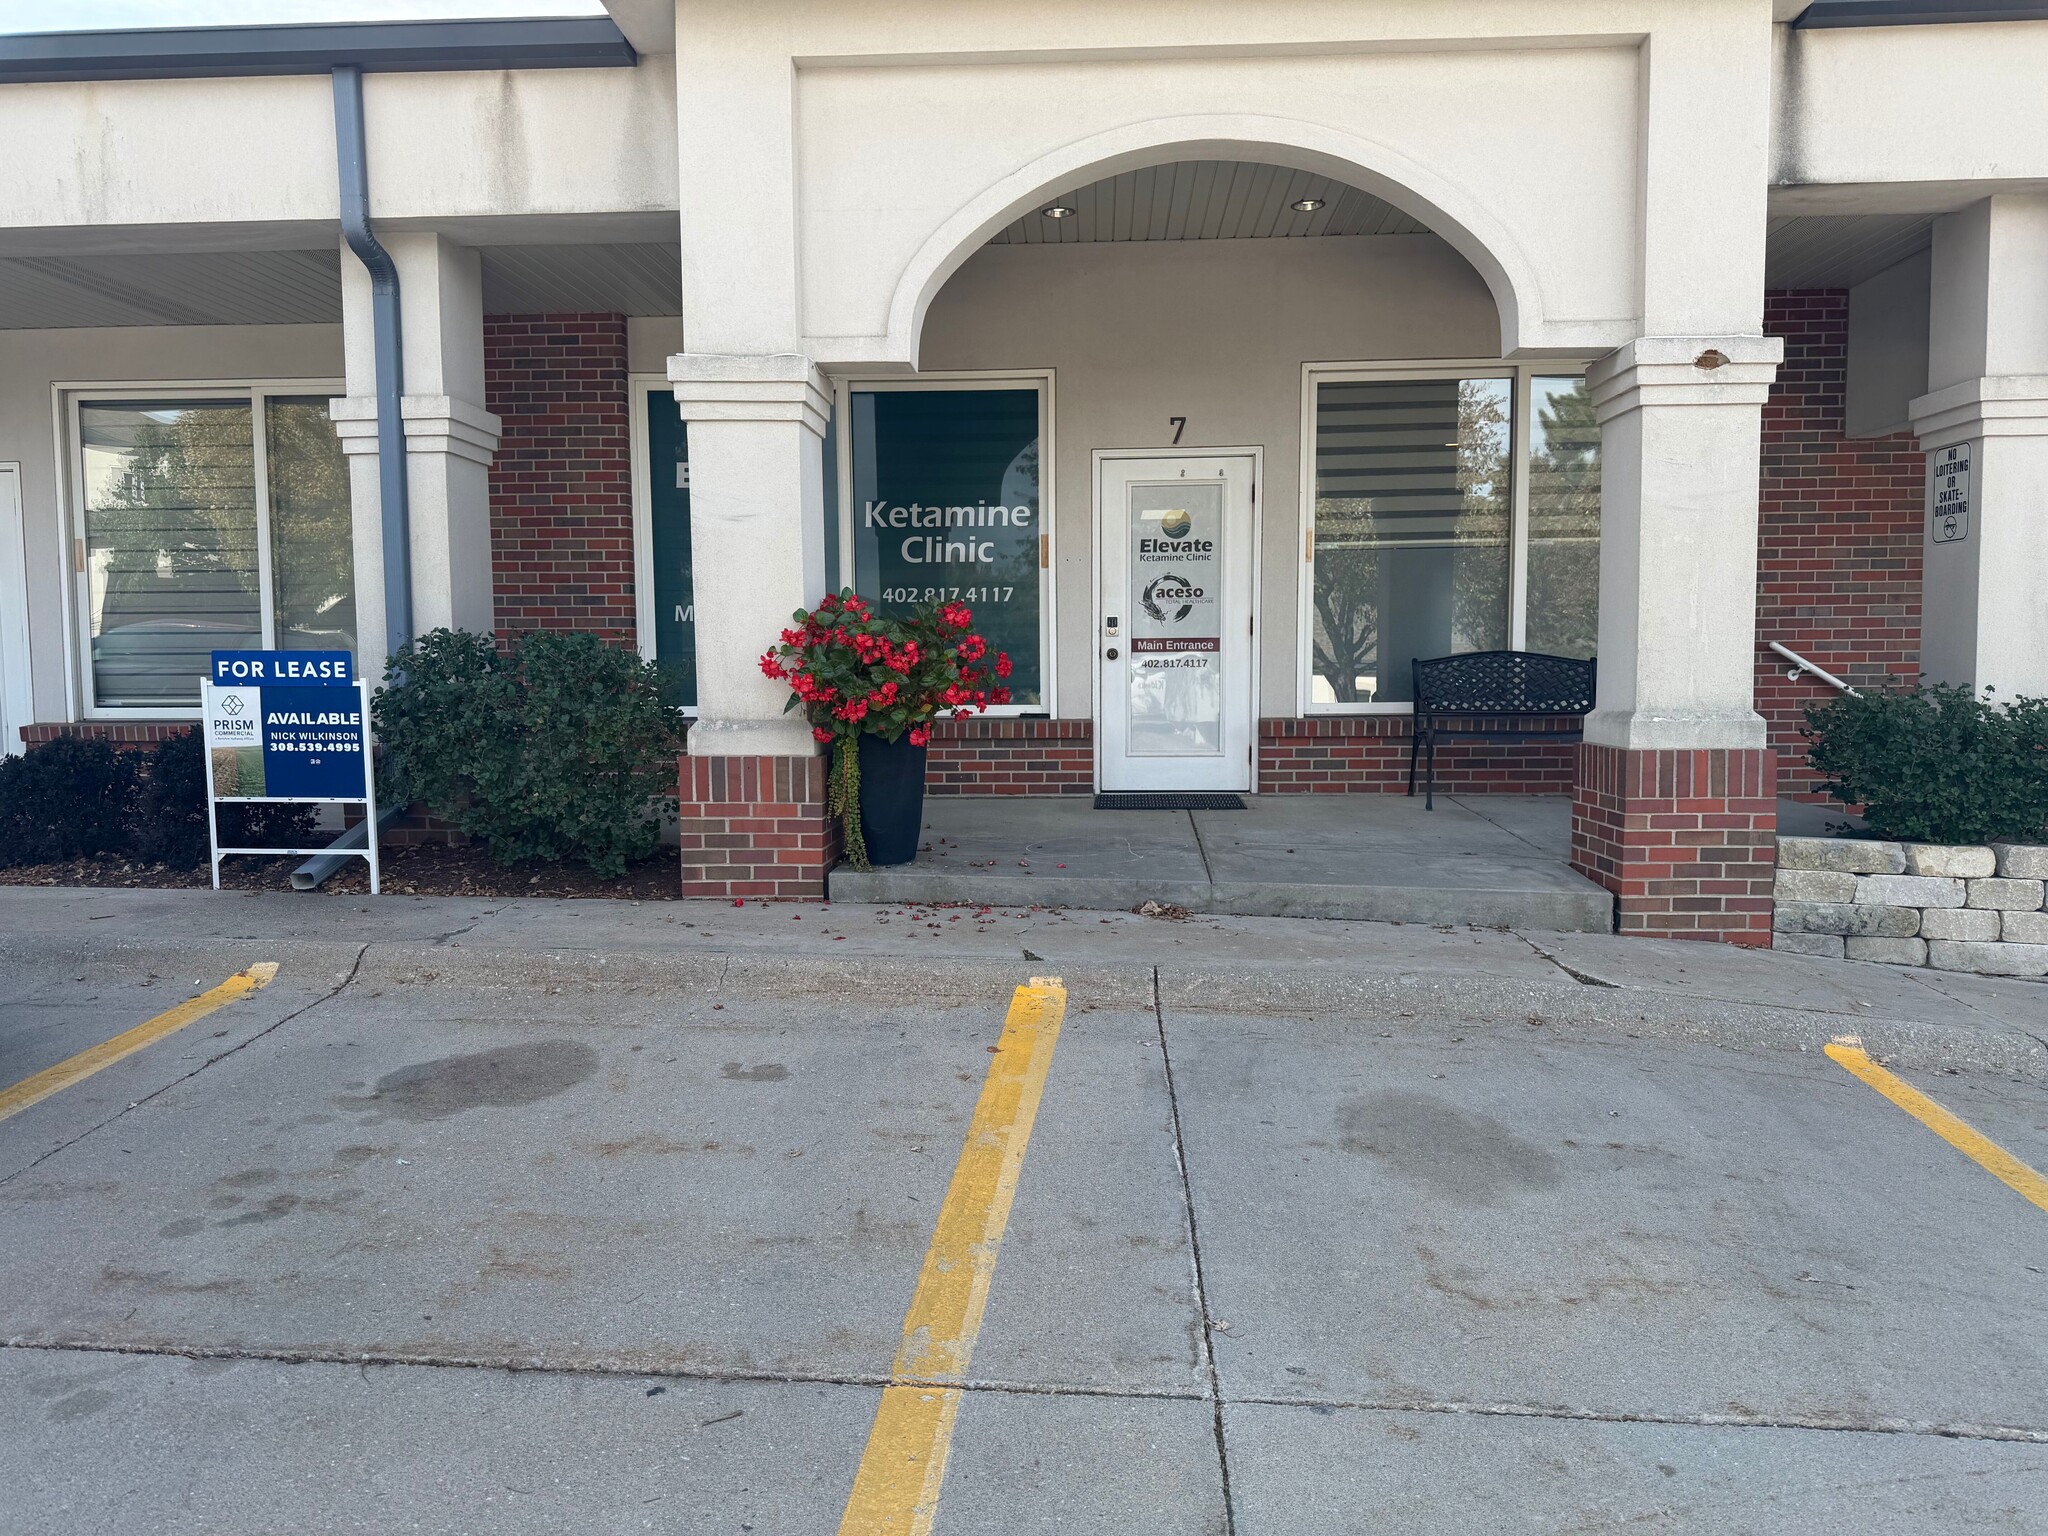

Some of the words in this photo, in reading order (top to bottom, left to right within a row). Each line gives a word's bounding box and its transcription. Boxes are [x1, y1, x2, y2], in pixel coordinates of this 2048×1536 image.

[1170, 416, 1187, 444] 7
[1948, 448, 1957, 460] NO
[1936, 460, 1969, 478] LOITERING
[1948, 476, 1956, 488] OR
[1940, 489, 1963, 503] SKATE-
[865, 500, 1030, 529] Ketamine
[1935, 501, 1967, 518] BOARDING
[901, 535, 995, 564] Clinic
[1140, 538, 1213, 552] Elevate
[1140, 553, 1184, 562] Ketamine
[1186, 552, 1212, 562] Clinic
[882, 587, 1014, 603] 402.817.4117
[1156, 588, 1204, 598] aceso
[1138, 640, 1163, 650] Main
[1166, 640, 1214, 650] Entrance
[218, 661, 264, 678] FOR
[275, 661, 347, 678] LEASE
[1141, 658, 1208, 668] 402.817.4117
[214, 720, 254, 730] PRISM
[267, 712, 360, 725] AVAILABLE
[270, 732, 297, 740] NICK
[298, 732, 358, 740] WILKINSON
[270, 743, 360, 752] 308.539.4995
